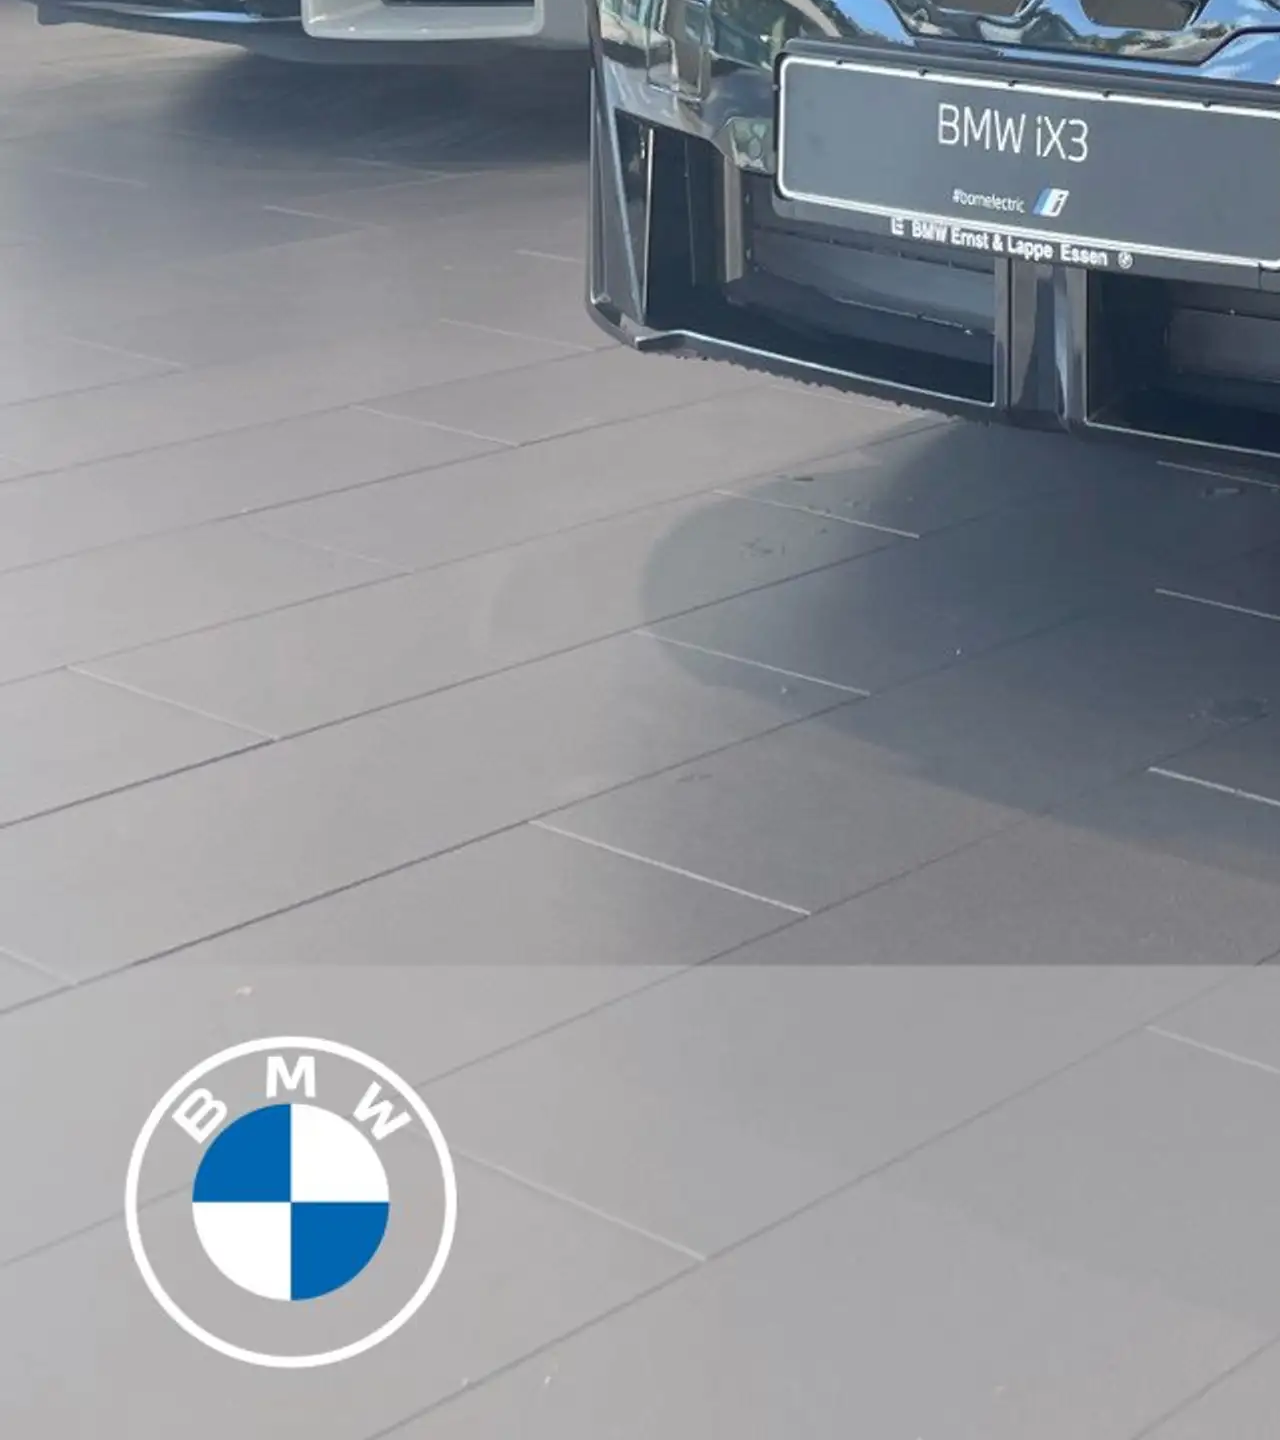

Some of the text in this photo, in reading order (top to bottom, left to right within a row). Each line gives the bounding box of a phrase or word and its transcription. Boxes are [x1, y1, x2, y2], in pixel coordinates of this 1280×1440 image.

[938, 102, 1089, 163] BMW iX3
[911, 219, 948, 243] BMW
[951, 227, 989, 250] Ernst
[992, 232, 1004, 252] &
[1007, 235, 1053, 262] Lappe
[1060, 244, 1109, 266] Essen
